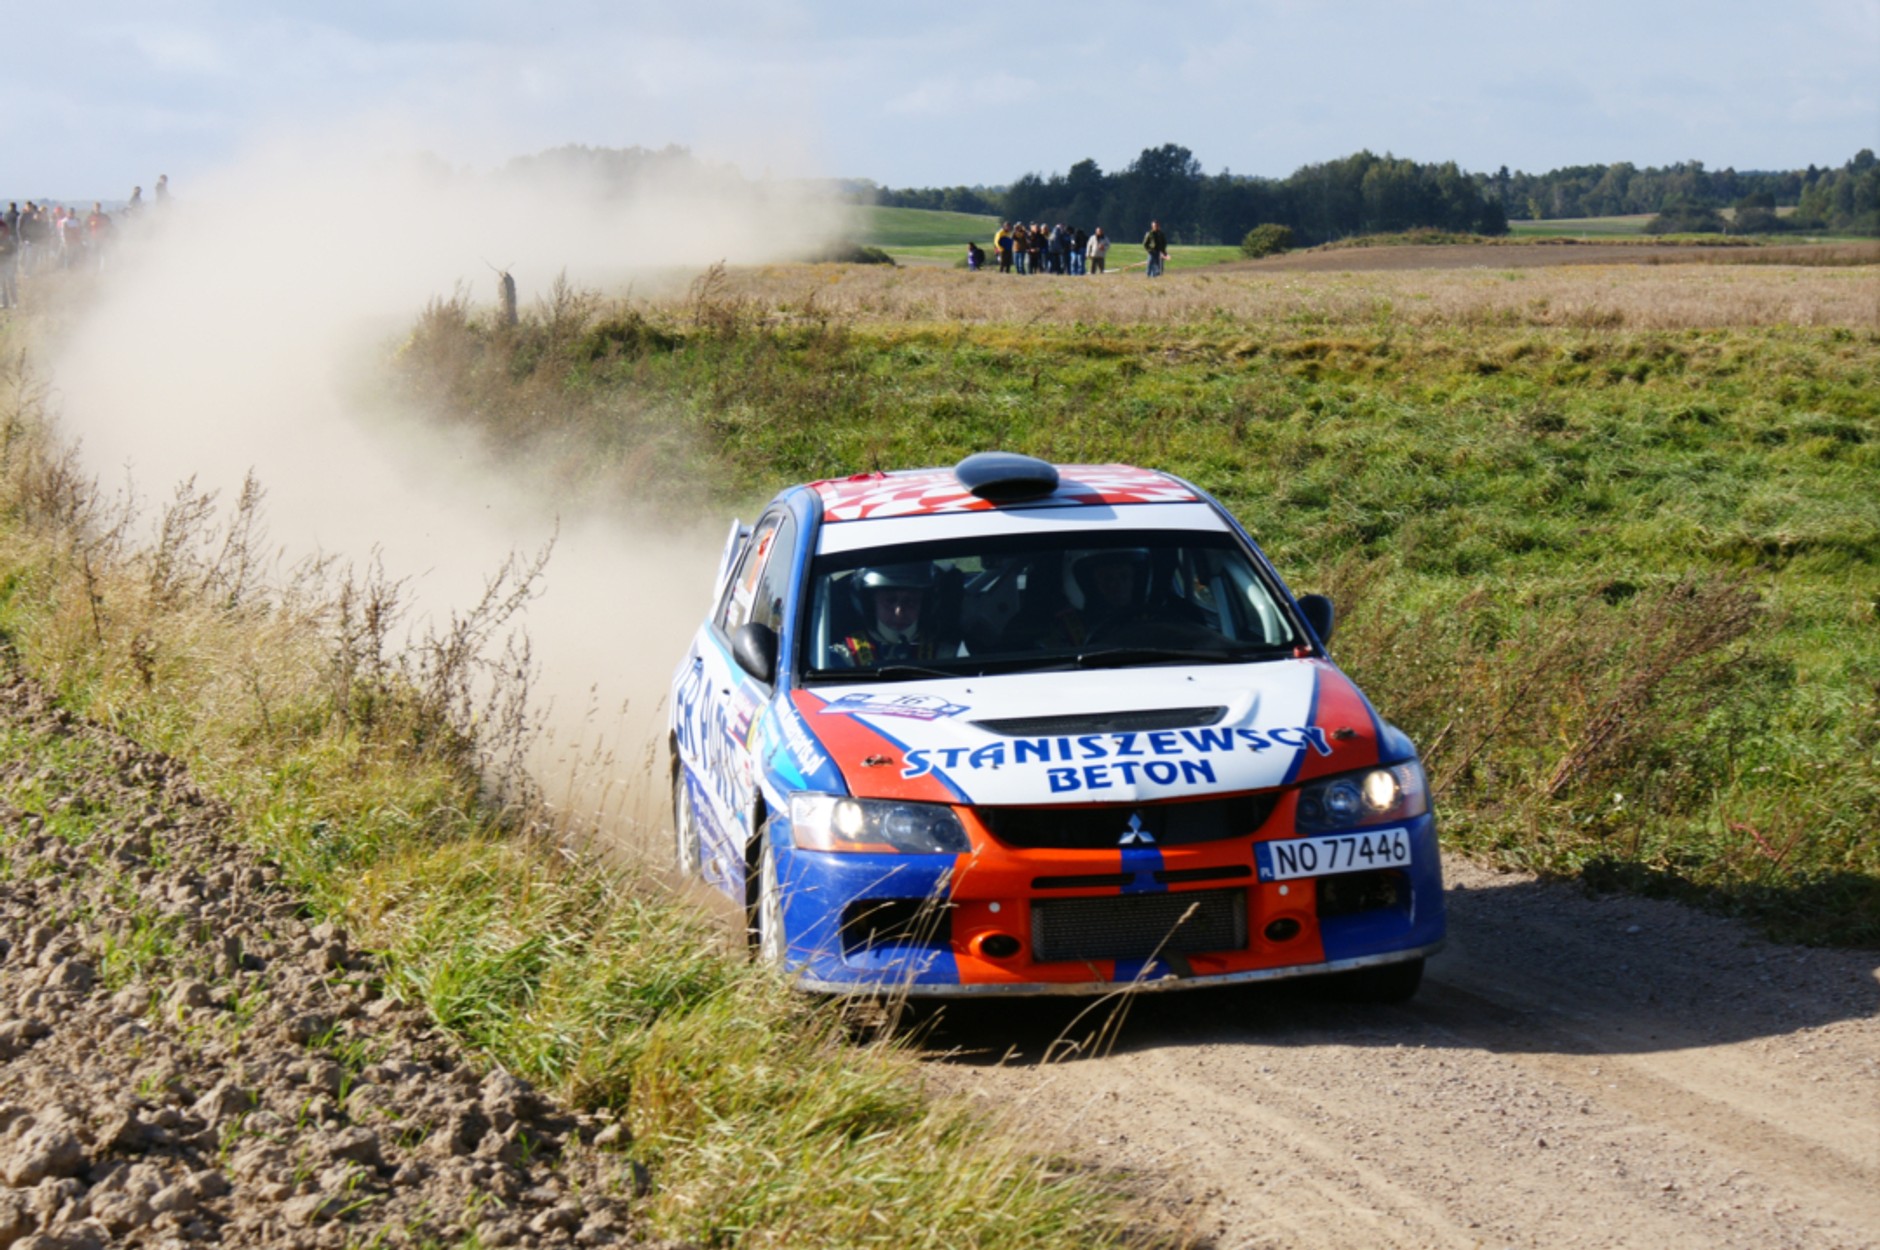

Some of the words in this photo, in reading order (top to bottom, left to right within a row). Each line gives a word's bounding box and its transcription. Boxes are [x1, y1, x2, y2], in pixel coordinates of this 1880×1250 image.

[902, 727, 1331, 776] STANISZEWSCY
[1047, 759, 1217, 793] BETON
[1260, 867, 1273, 878] PL
[1275, 842, 1318, 875] NO
[1322, 832, 1406, 869] 77446
